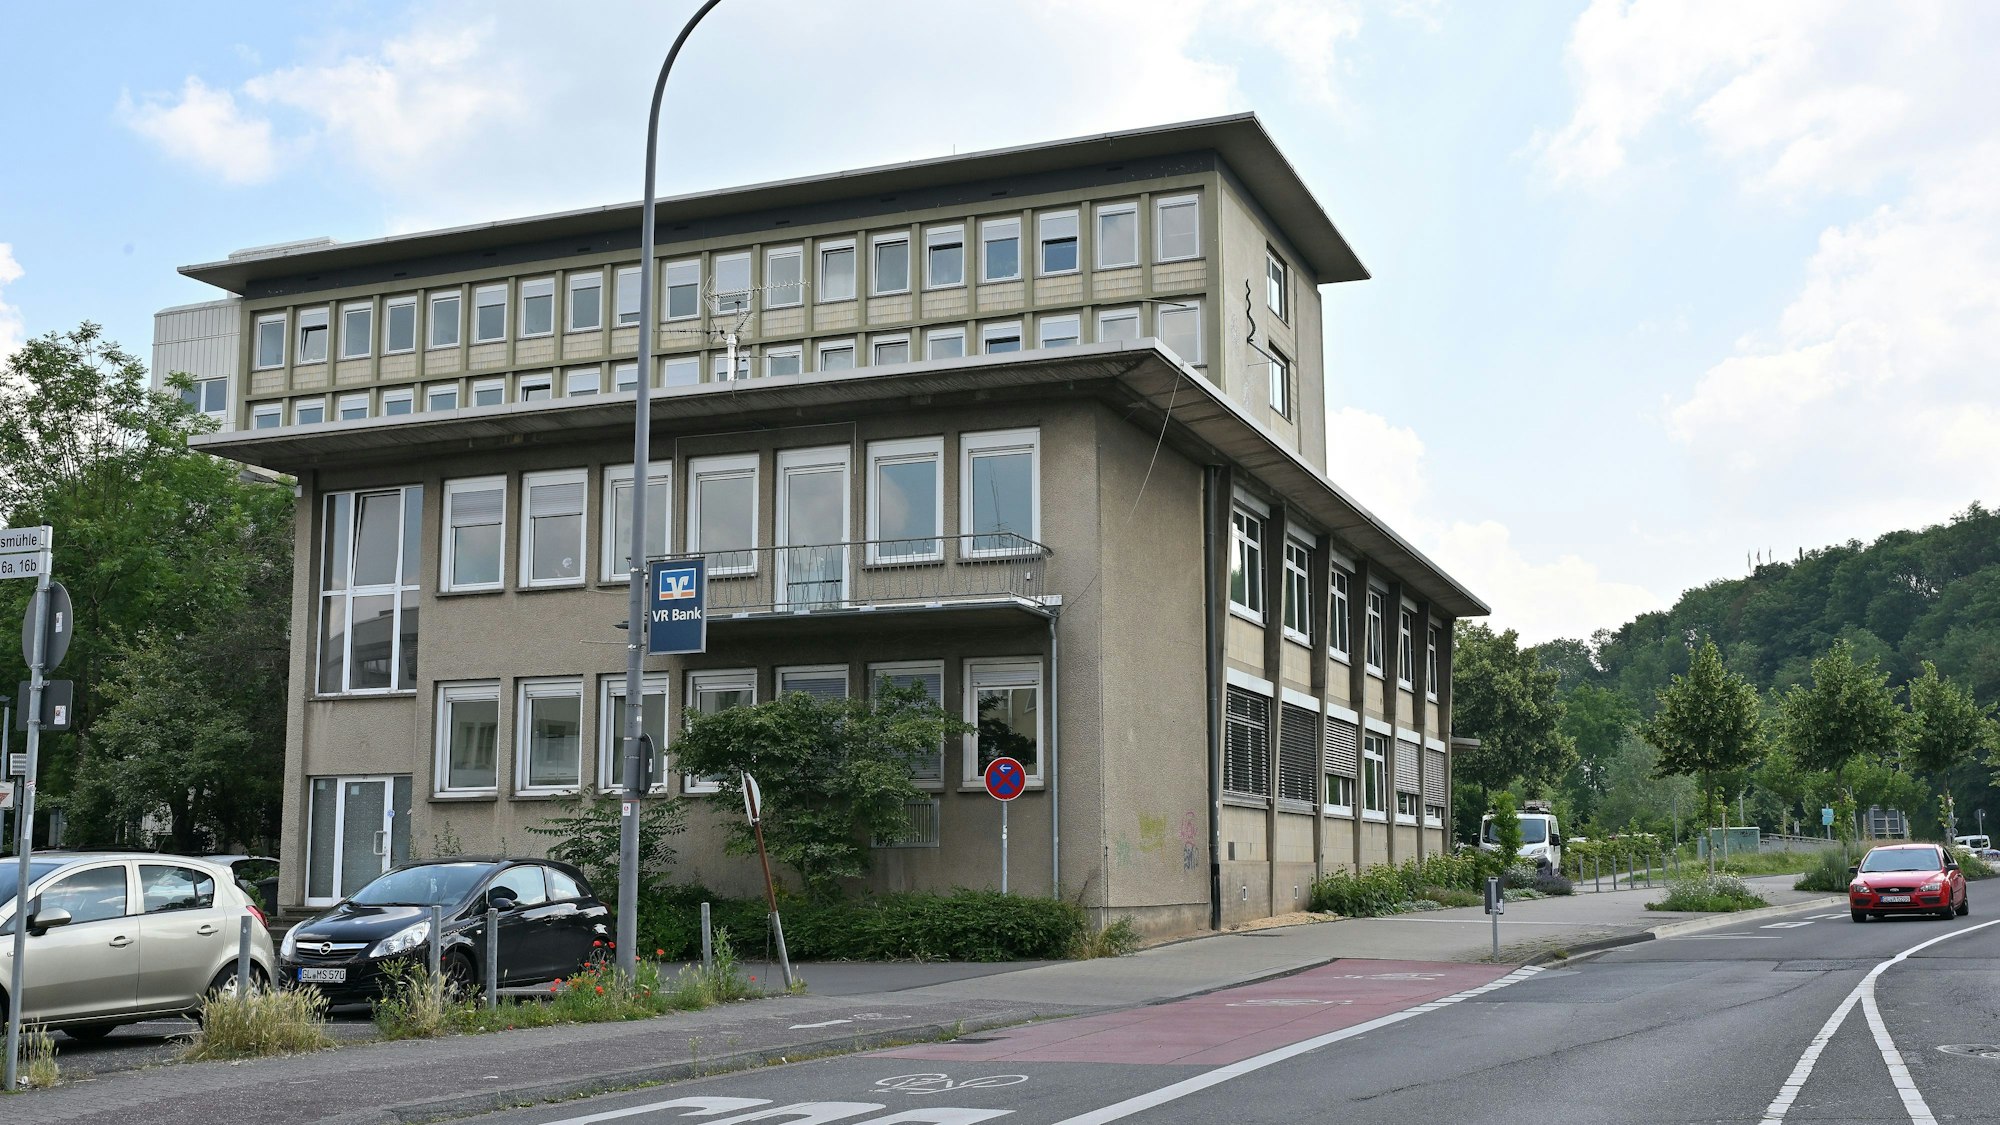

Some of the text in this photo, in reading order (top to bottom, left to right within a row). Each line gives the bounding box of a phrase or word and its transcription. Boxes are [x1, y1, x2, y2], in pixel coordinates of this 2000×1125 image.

[0, 533, 37, 548] smühle
[1, 559, 37, 575] 6a, 16b
[652, 606, 702, 623] VR Bank
